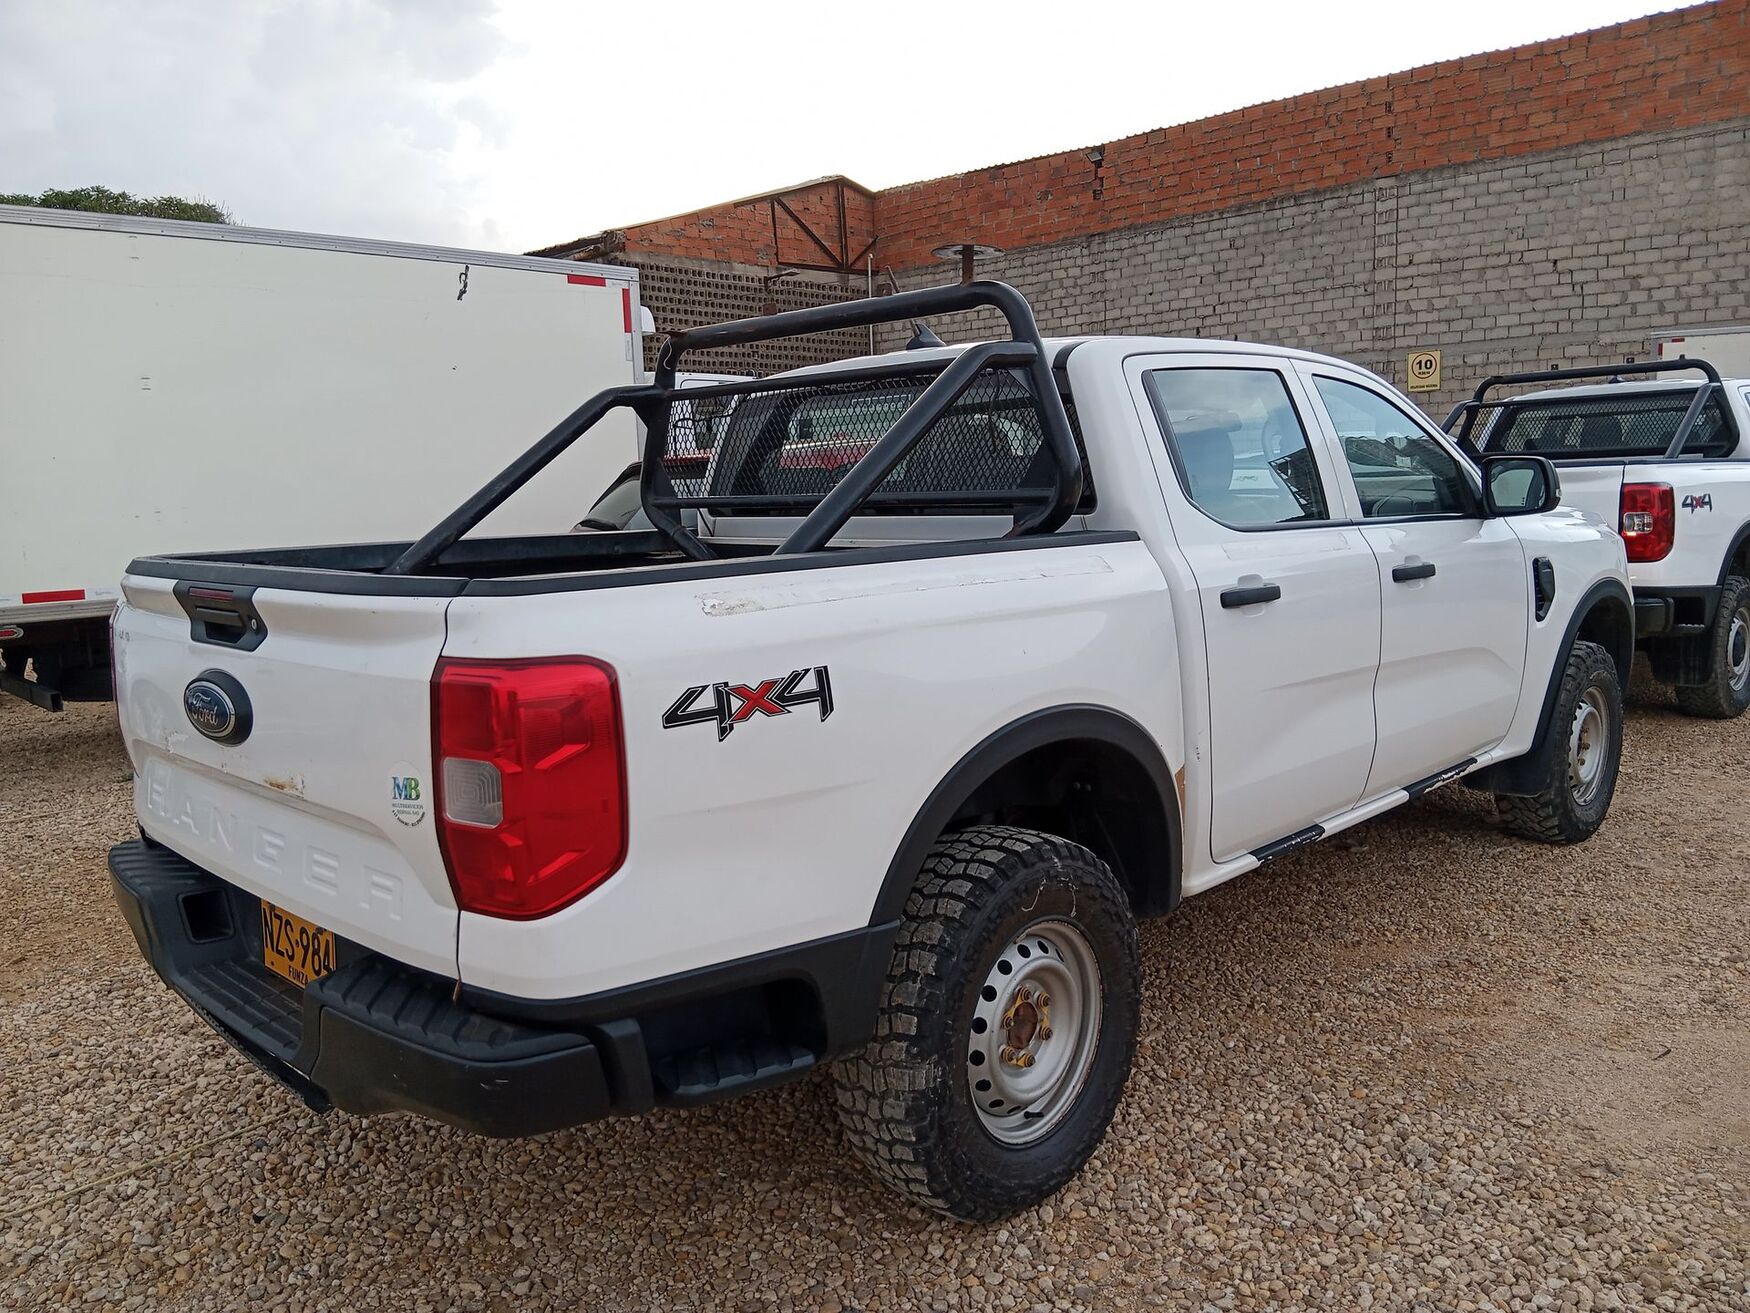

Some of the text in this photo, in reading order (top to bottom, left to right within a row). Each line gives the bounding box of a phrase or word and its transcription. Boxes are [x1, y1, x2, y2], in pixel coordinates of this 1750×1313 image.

[1416, 359, 1433, 370] 10
[191, 692, 218, 725] Ford
[392, 776, 421, 801] MB
[146, 759, 404, 921] RANGER
[288, 965, 309, 985] FUNZA
